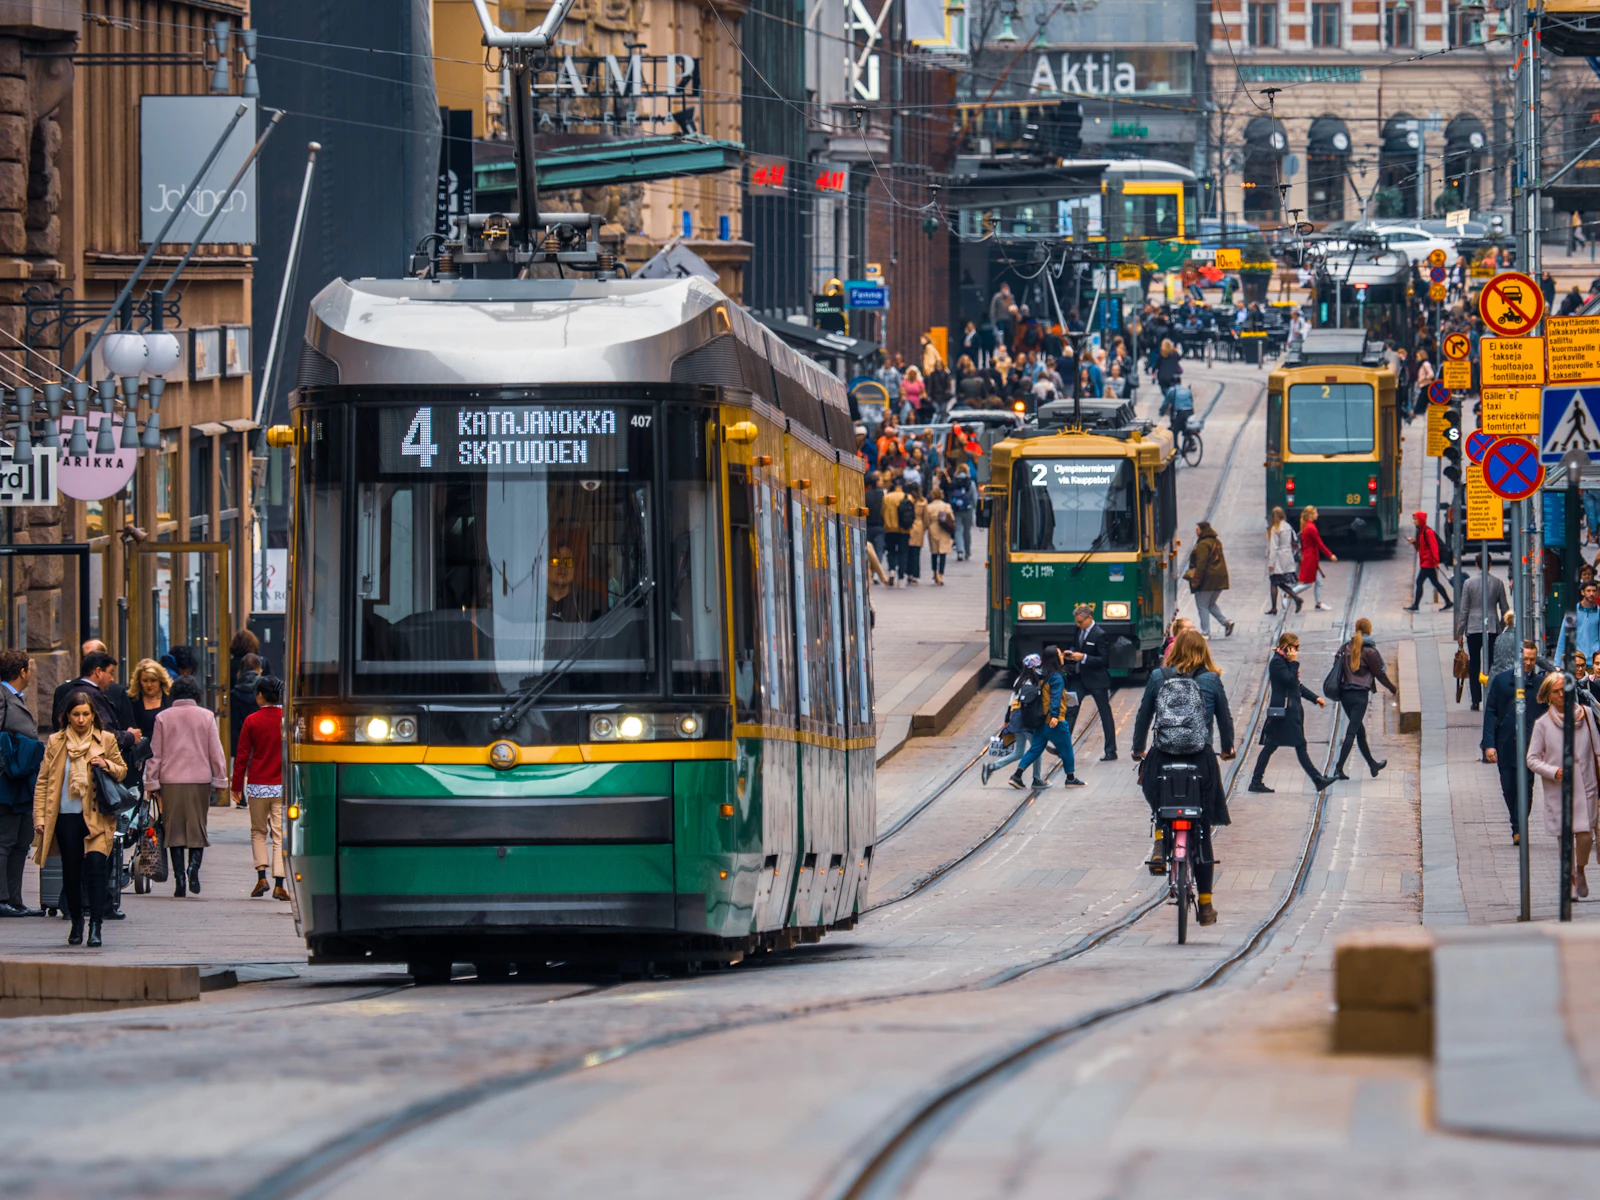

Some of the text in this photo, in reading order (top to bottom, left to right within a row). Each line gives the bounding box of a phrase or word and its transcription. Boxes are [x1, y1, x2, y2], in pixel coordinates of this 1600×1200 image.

[1030, 52, 1136, 94] Aktia
[1489, 342, 1523, 350] Ei koske
[1321, 385, 1331, 398] 2
[1484, 391, 1517, 401] Gäller ej
[401, 407, 652, 467] 4 KATAJANOKKA 407
[1449, 428, 1460, 440] S
[458, 439, 588, 464] SKATUDDEN
[57, 457, 124, 469] ARIKKA
[1031, 463, 1047, 486] 2
[1058, 476, 1070, 485] via
[1346, 494, 1361, 504] 89
